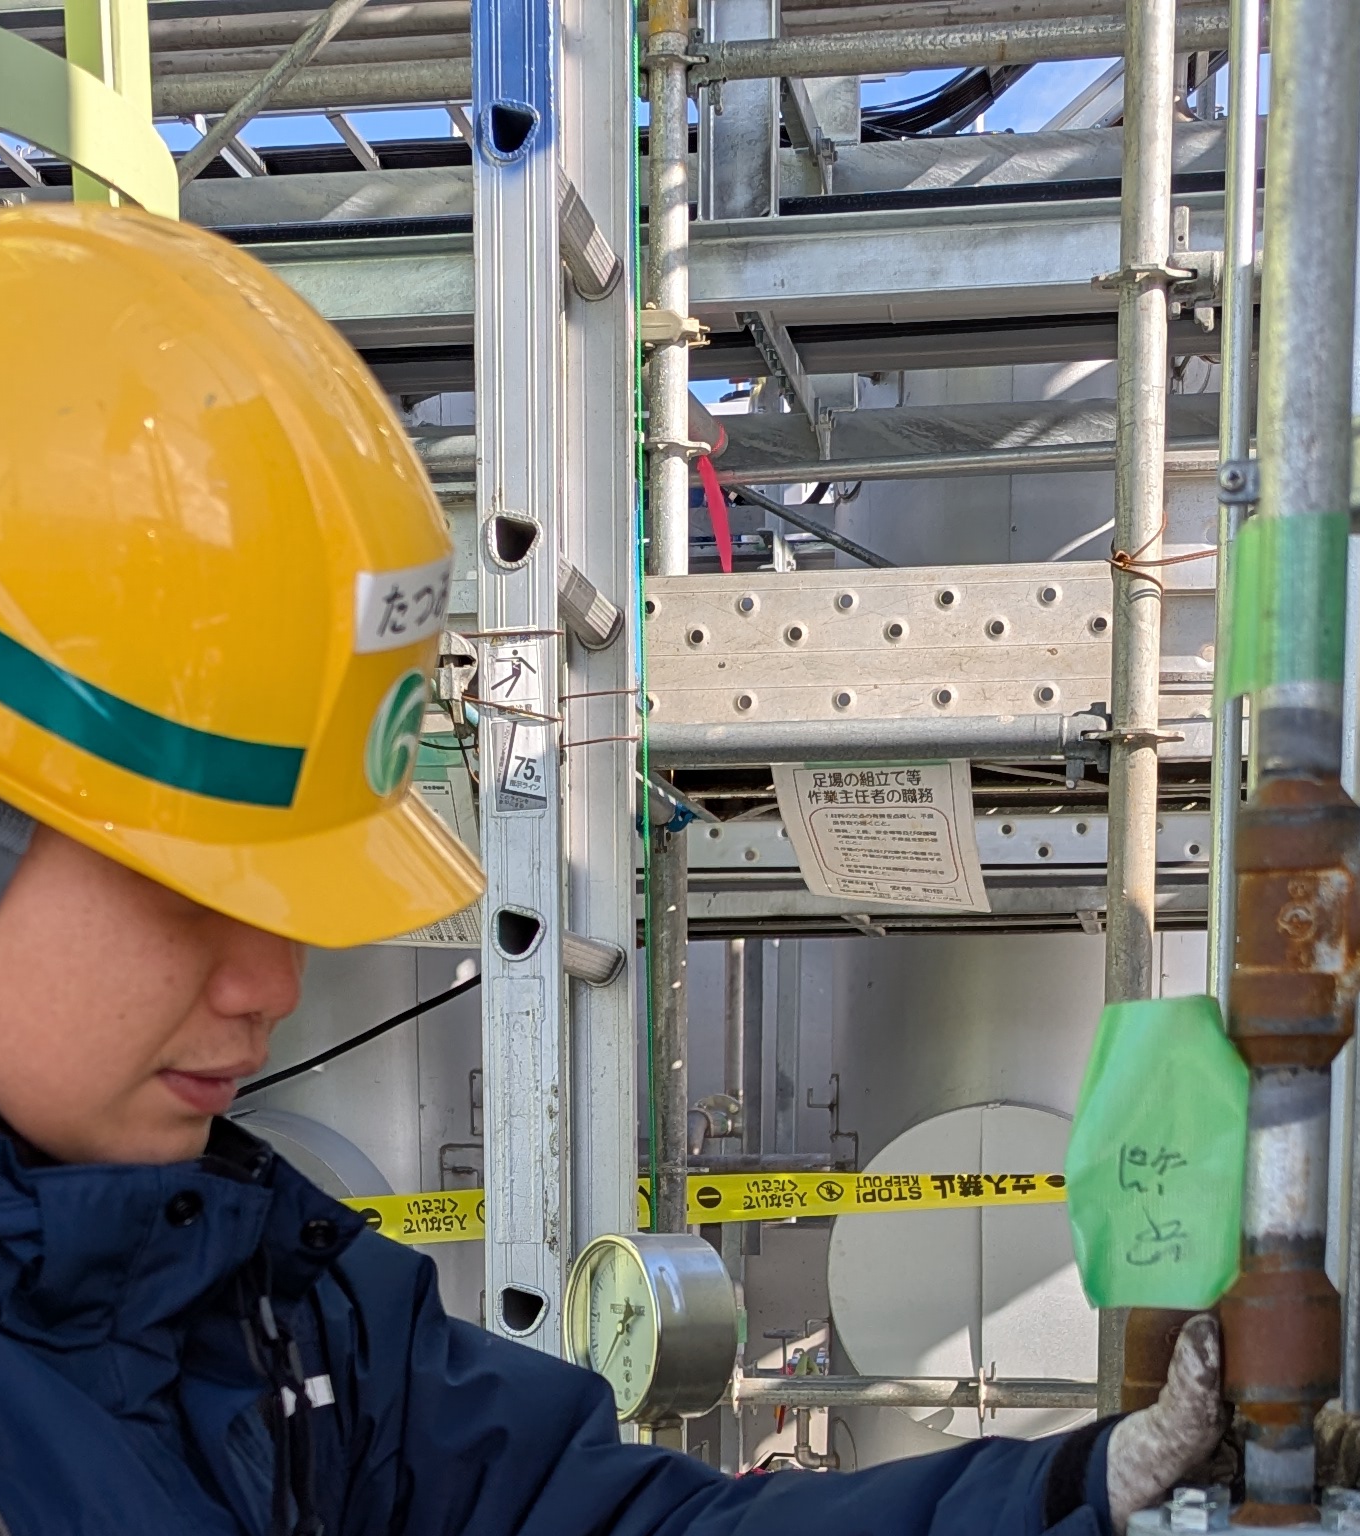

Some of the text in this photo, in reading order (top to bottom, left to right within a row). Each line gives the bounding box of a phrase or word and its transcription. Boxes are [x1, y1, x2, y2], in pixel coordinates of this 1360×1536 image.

[812, 769, 922, 789] 足場の組立て等
[807, 788, 934, 805] 作業主任者の職務
[747, 1178, 798, 1194] ください
[856, 1175, 920, 1188] KEEP OUT
[930, 1174, 1037, 1199] 立入禁止
[856, 1186, 923, 1204] STOP!
[406, 1198, 459, 1216] ください
